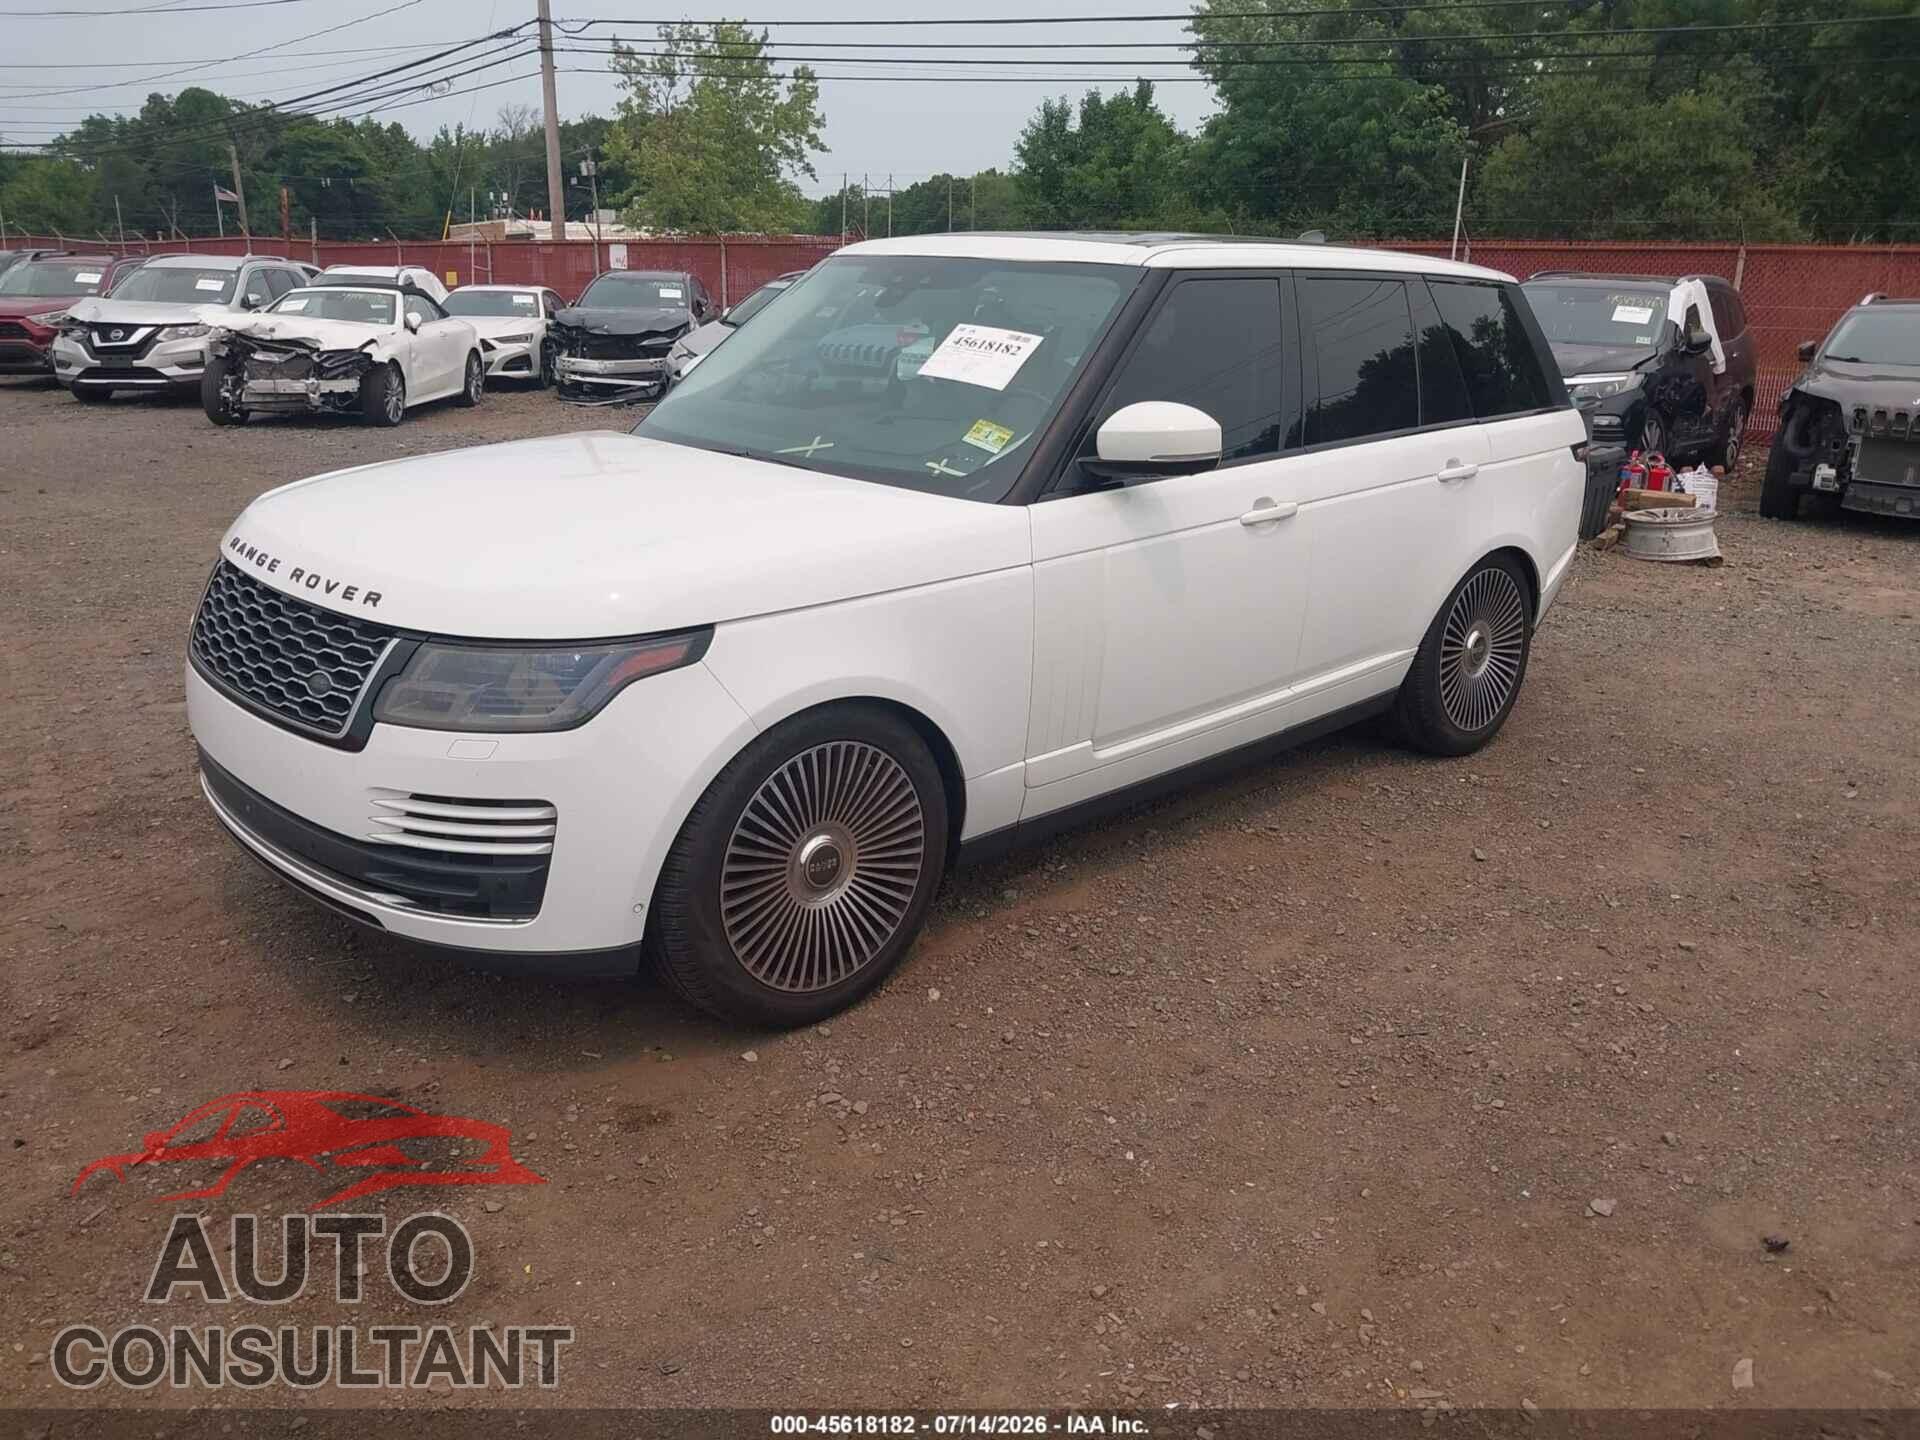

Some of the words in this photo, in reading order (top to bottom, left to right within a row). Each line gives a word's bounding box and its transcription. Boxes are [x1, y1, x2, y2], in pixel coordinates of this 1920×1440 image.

[952, 336, 1022, 356] 45618182
[229, 536, 281, 573] RANGE
[289, 567, 383, 608] ROVER
